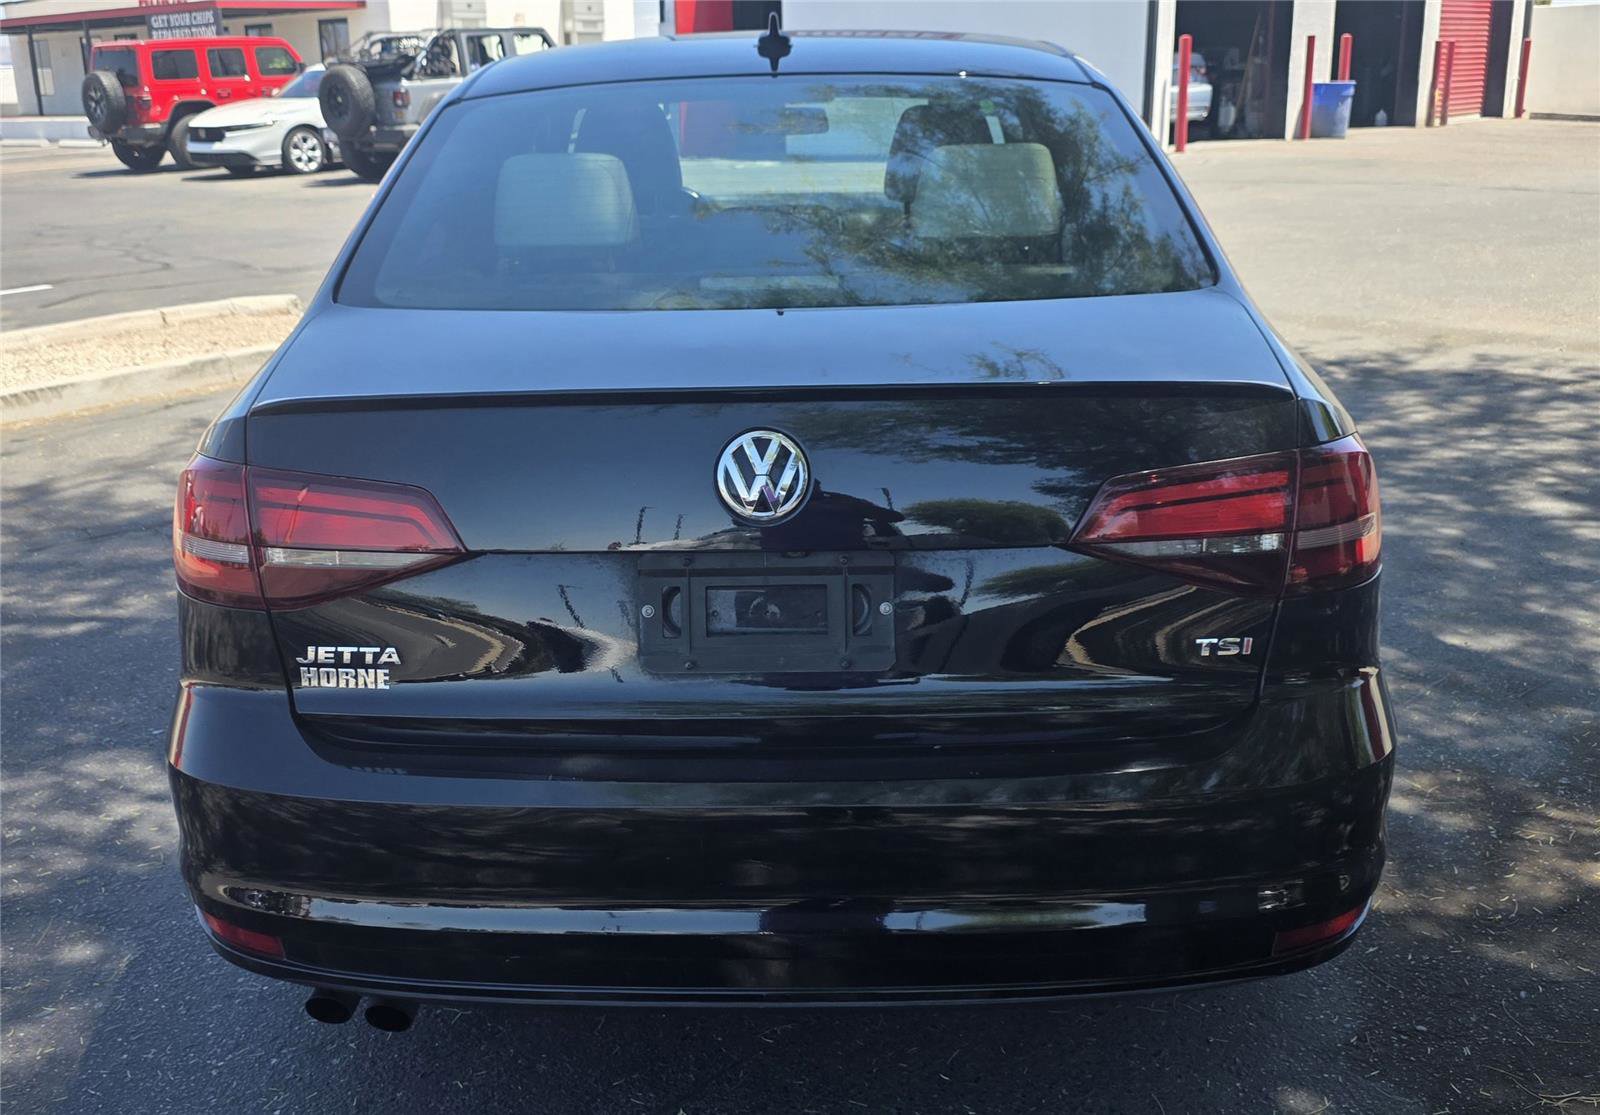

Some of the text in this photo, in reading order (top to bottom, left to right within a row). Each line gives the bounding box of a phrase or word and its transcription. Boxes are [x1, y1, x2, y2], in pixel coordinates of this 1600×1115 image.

[151, 10, 215, 28] GET YOUR CHIPS
[295, 645, 402, 665] JETTA
[1195, 636, 1253, 656] TSI
[299, 667, 390, 690] HORNE
